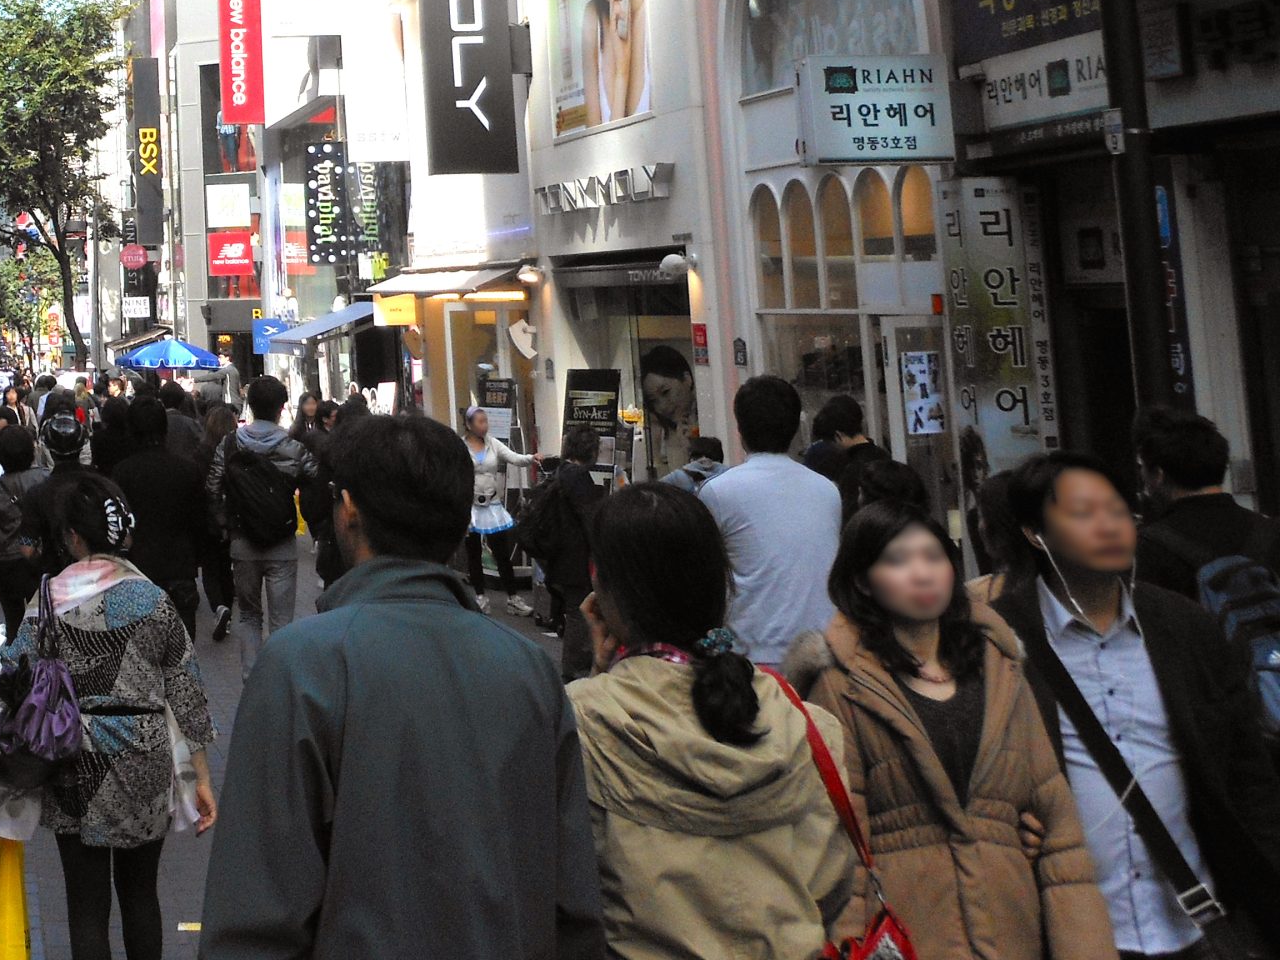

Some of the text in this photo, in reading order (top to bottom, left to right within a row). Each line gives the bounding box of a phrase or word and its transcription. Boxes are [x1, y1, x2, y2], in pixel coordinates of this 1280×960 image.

[230, 28, 249, 107] balance
[861, 68, 933, 84] RIAHN
[986, 69, 1043, 106] 리안헤어
[830, 102, 936, 127] 리안헤어
[138, 127, 158, 176] BSX
[852, 135, 918, 151] 명동3호점
[124, 298, 148, 306] NINE
[124, 307, 149, 315] WEST
[946, 209, 978, 426] 리안헤어
[979, 207, 1030, 427] 리안헤어
